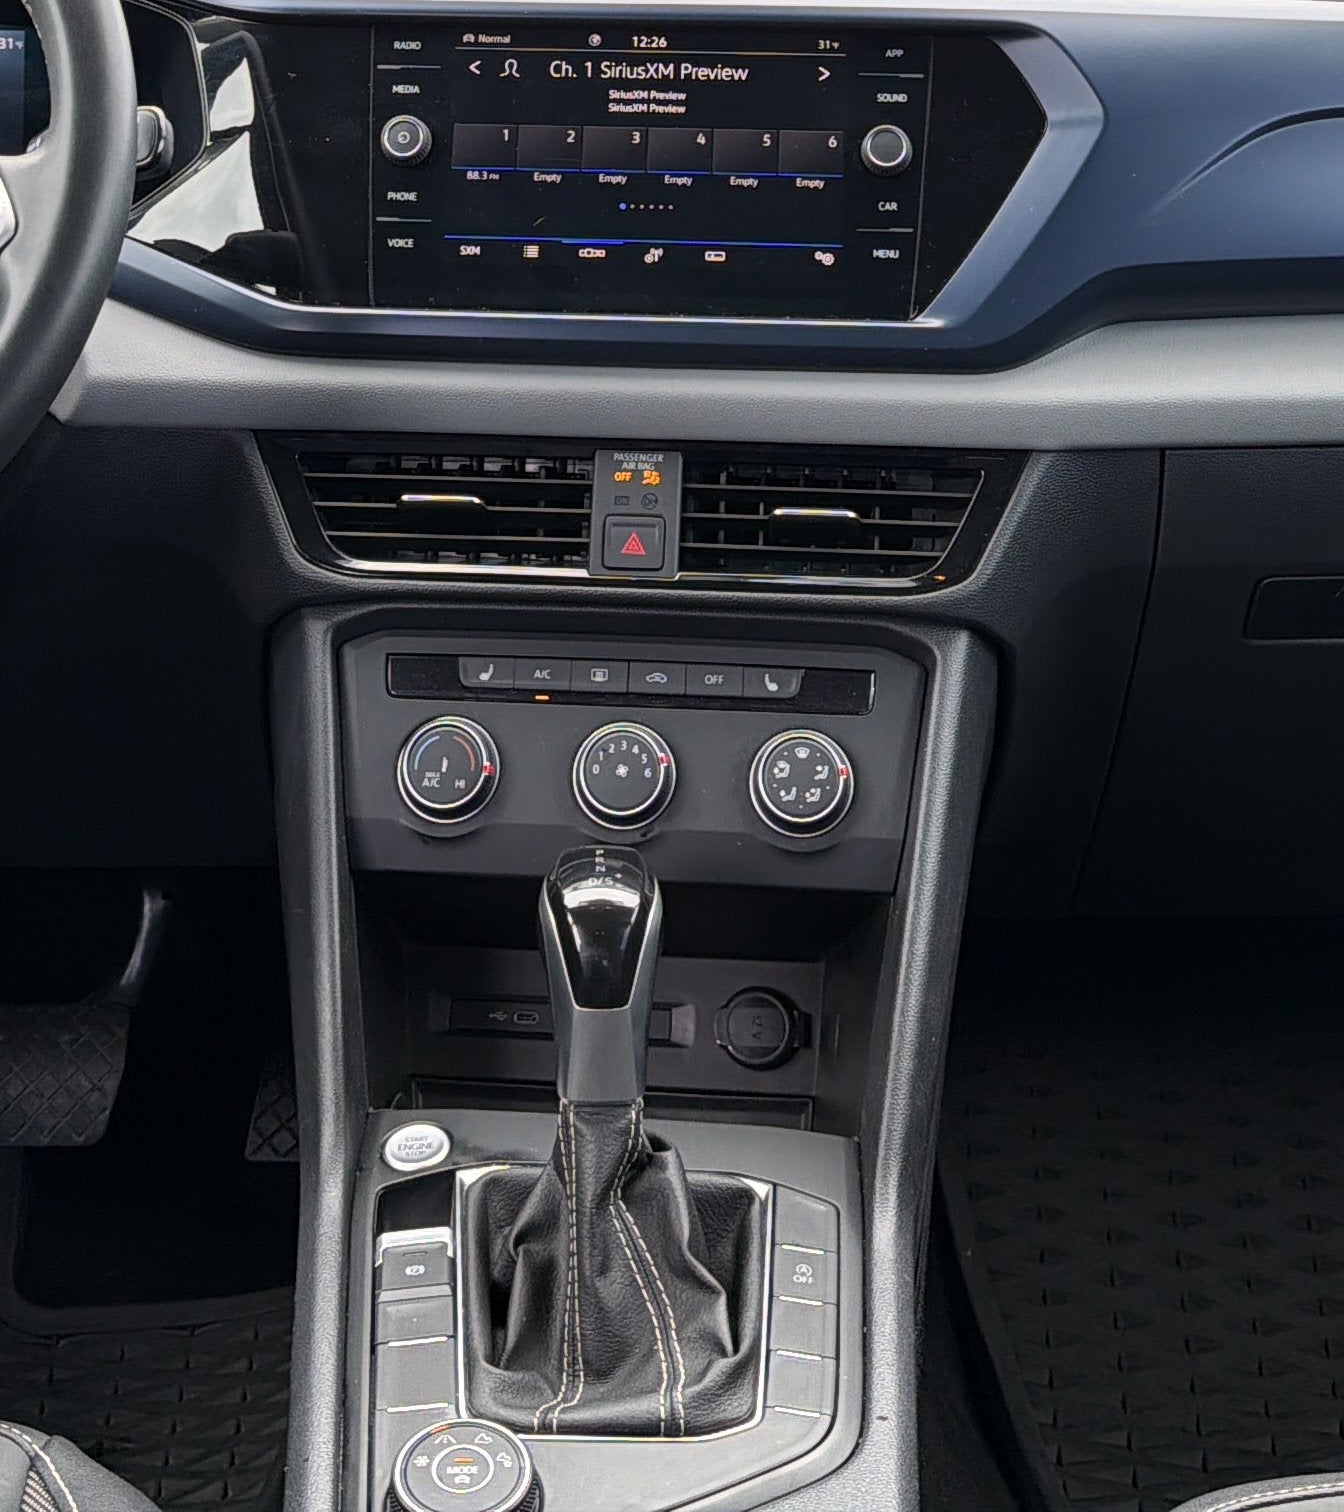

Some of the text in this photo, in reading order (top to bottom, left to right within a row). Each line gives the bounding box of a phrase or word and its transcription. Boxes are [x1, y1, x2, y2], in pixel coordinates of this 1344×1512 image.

[478, 33, 511, 44] Normal
[631, 36, 668, 48] 12:26
[393, 40, 422, 51] RADIO
[884, 49, 904, 58] APP
[549, 60, 749, 81] Ch. 1 SiriusXM Preview
[391, 84, 421, 94] MEDIA
[608, 89, 687, 101] SiriusXM Preview
[876, 92, 908, 103] SOUND
[608, 102, 686, 114] SiriusXM Preview
[502, 129, 509, 142] 1
[566, 130, 576, 143] 2
[631, 131, 641, 144] 3
[696, 132, 706, 145] 4
[761, 133, 772, 147] 5
[828, 135, 838, 148] 6
[466, 170, 488, 181] 88.3
[533, 172, 563, 184] Empty
[598, 173, 628, 186] Empty
[664, 174, 693, 187] Empty
[730, 176, 759, 188] Empty
[796, 178, 825, 190] Empty
[387, 191, 418, 202] PHONE
[878, 201, 898, 211] CAR
[387, 238, 415, 248] VOICE
[459, 245, 481, 256] SXM
[872, 249, 900, 259] MENU
[613, 452, 665, 463] PASSENGER
[621, 461, 655, 471] AIR BAG
[613, 471, 633, 482] OFF
[615, 496, 629, 505] ON
[533, 668, 552, 679] A/C
[704, 674, 724, 685] OFF
[608, 743, 615, 754] 2
[620, 740, 628, 750] 3
[631, 744, 640, 754] 4
[598, 751, 604, 761] 1
[641, 753, 648, 764] 5
[592, 764, 600, 774] 0
[644, 767, 652, 778] 6
[421, 778, 441, 788] A/C
[454, 779, 466, 789] HI
[595, 856, 605, 864] R
[595, 865, 606, 873] N
[404, 1135, 429, 1143] START
[397, 1141, 434, 1152] ENGINE
[792, 1274, 815, 1285] OFF
[446, 1464, 479, 1475] MODE
